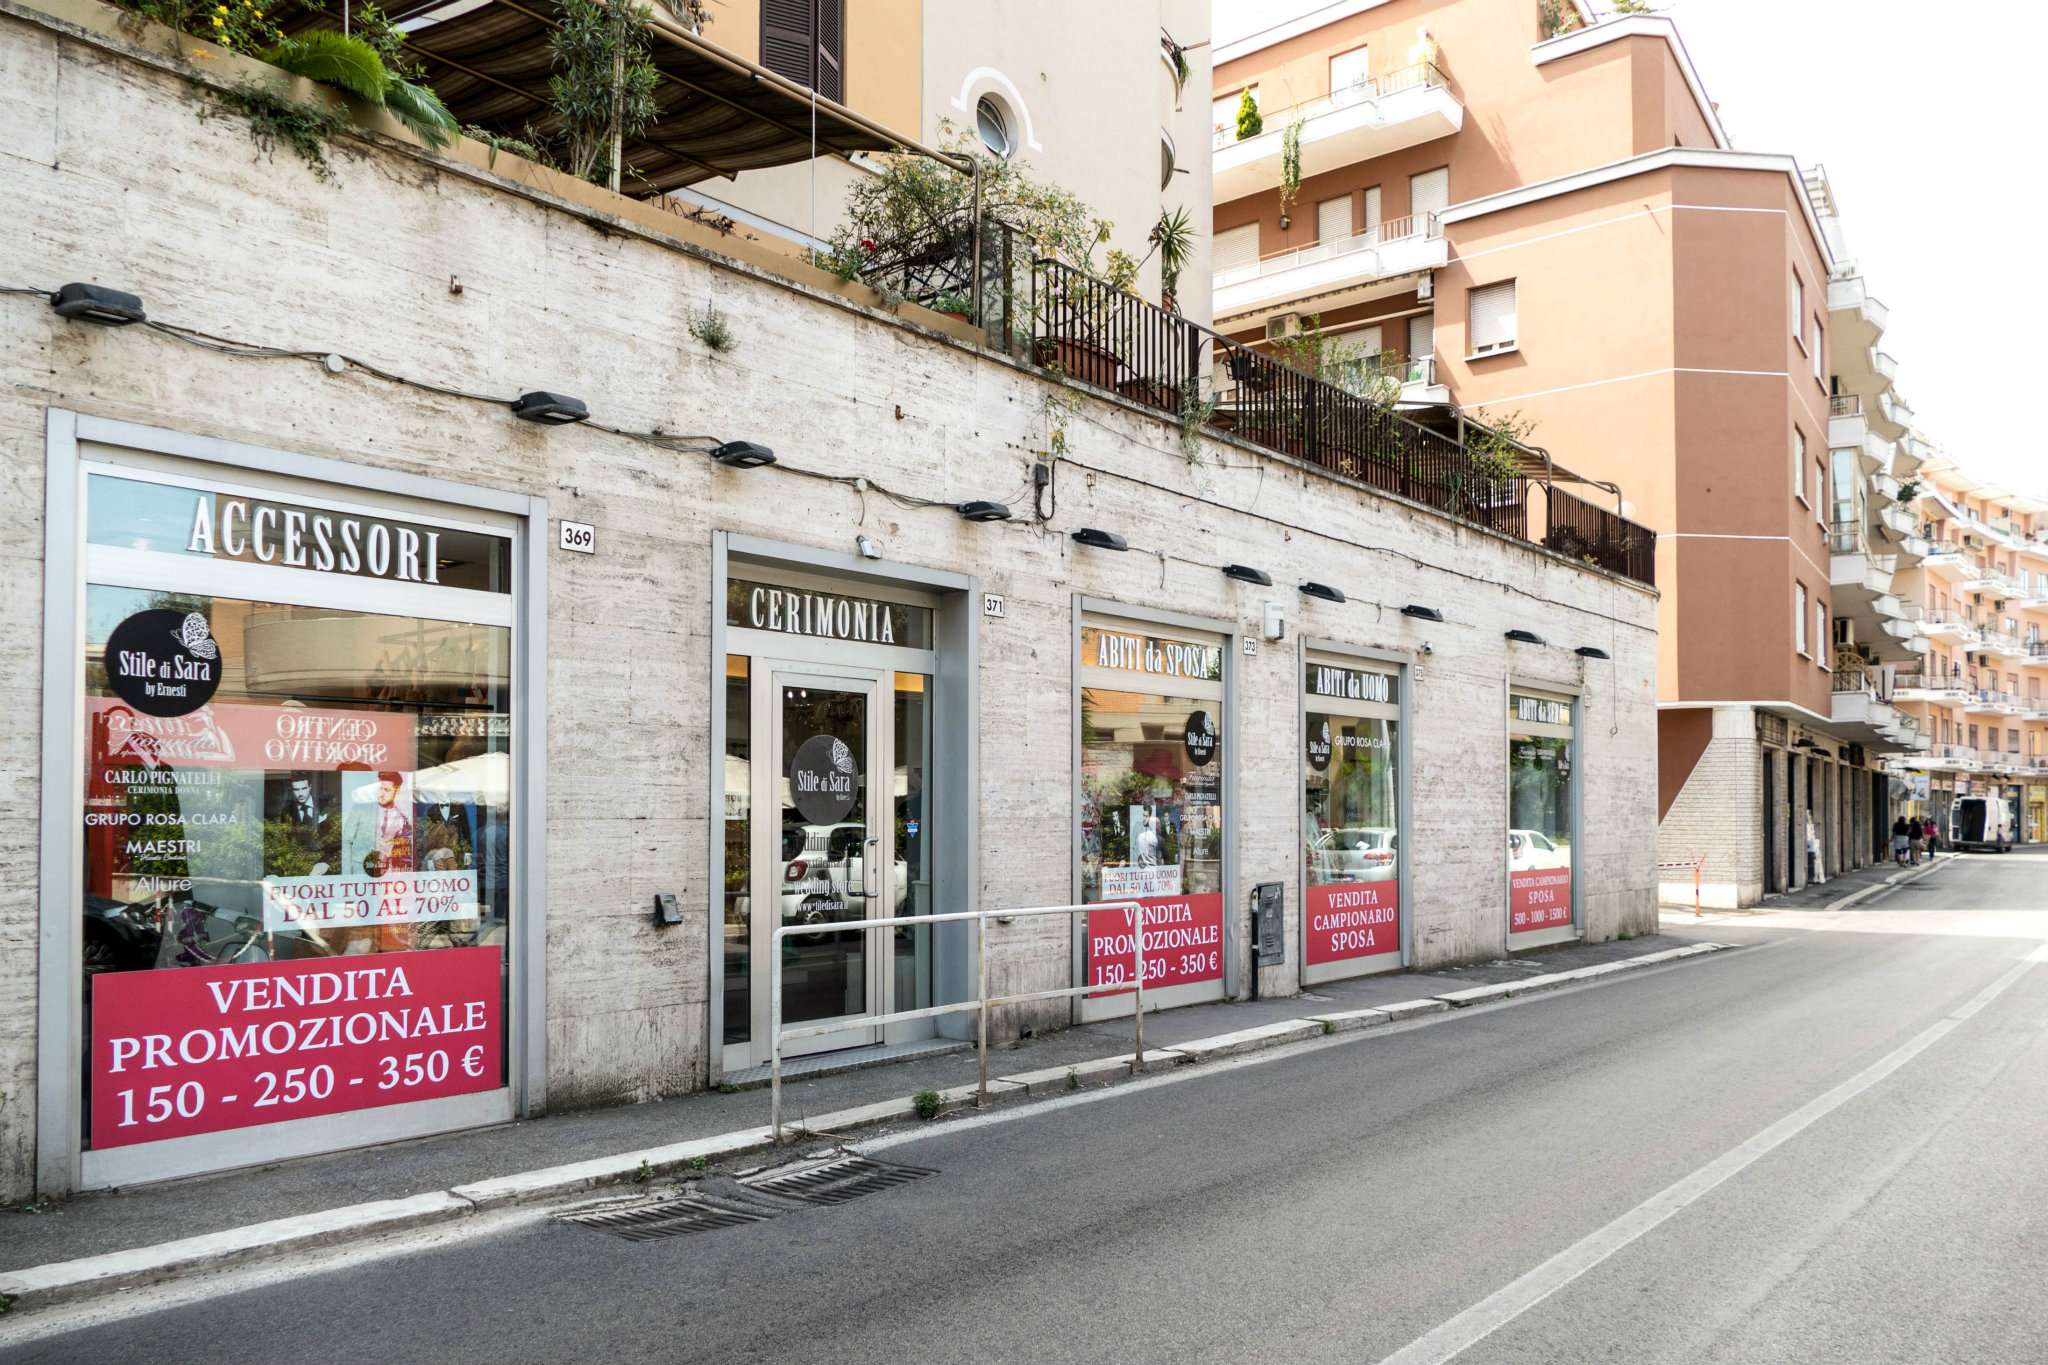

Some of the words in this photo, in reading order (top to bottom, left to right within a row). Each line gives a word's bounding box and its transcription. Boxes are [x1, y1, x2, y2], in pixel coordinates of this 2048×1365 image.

[187, 496, 441, 584] ACCESSORI
[564, 527, 592, 547] 369
[750, 587, 895, 644] CERIMONIA
[985, 598, 1003, 613] 371
[119, 650, 156, 678] Stile
[160, 661, 171, 679] di
[174, 654, 211, 681] Sara
[1099, 633, 1141, 672] ABITI
[1145, 640, 1162, 673] da
[1166, 643, 1208, 679] SPOSA
[145, 682, 156, 698] by
[157, 682, 187, 698] Ernesti
[1316, 666, 1346, 697] ABITI
[1348, 672, 1361, 699] da
[1362, 673, 1389, 704] UOMO
[1356, 736, 1372, 748] ROSA
[104, 770, 148, 784] CARLO
[150, 771, 221, 785] PIGNATELLI
[797, 770, 820, 792] Stile
[829, 771, 850, 792] Sara
[128, 785, 173, 795] CERIMONIA
[85, 813, 141, 826] GRUPO
[146, 813, 185, 826] ROSA
[126, 839, 201, 854] MAESTRI
[136, 876, 193, 892] Allure
[270, 884, 335, 901] FUORI
[340, 880, 407, 897] TUTTO
[413, 877, 470, 894] UOMO
[1142, 881, 1155, 893] AL
[1328, 890, 1378, 908] VENDITA
[1528, 889, 1555, 905] SPOSA
[282, 902, 336, 923] DAL
[343, 899, 370, 918] 50
[376, 897, 408, 917] AL
[415, 895, 459, 915] 70%
[1313, 907, 1394, 931] CAMPIONARIO
[1331, 929, 1375, 952] SPOSA
[1096, 963, 1125, 986] 150
[1180, 952, 1205, 975] 350
[1209, 951, 1218, 971] €
[207, 966, 414, 1014] VENDITA
[108, 1000, 488, 1073] PROMOZIONALE
[117, 1080, 206, 1128] 150
[253, 1064, 335, 1108] 250
[377, 1050, 450, 1091] 350
[461, 1044, 485, 1078] €
